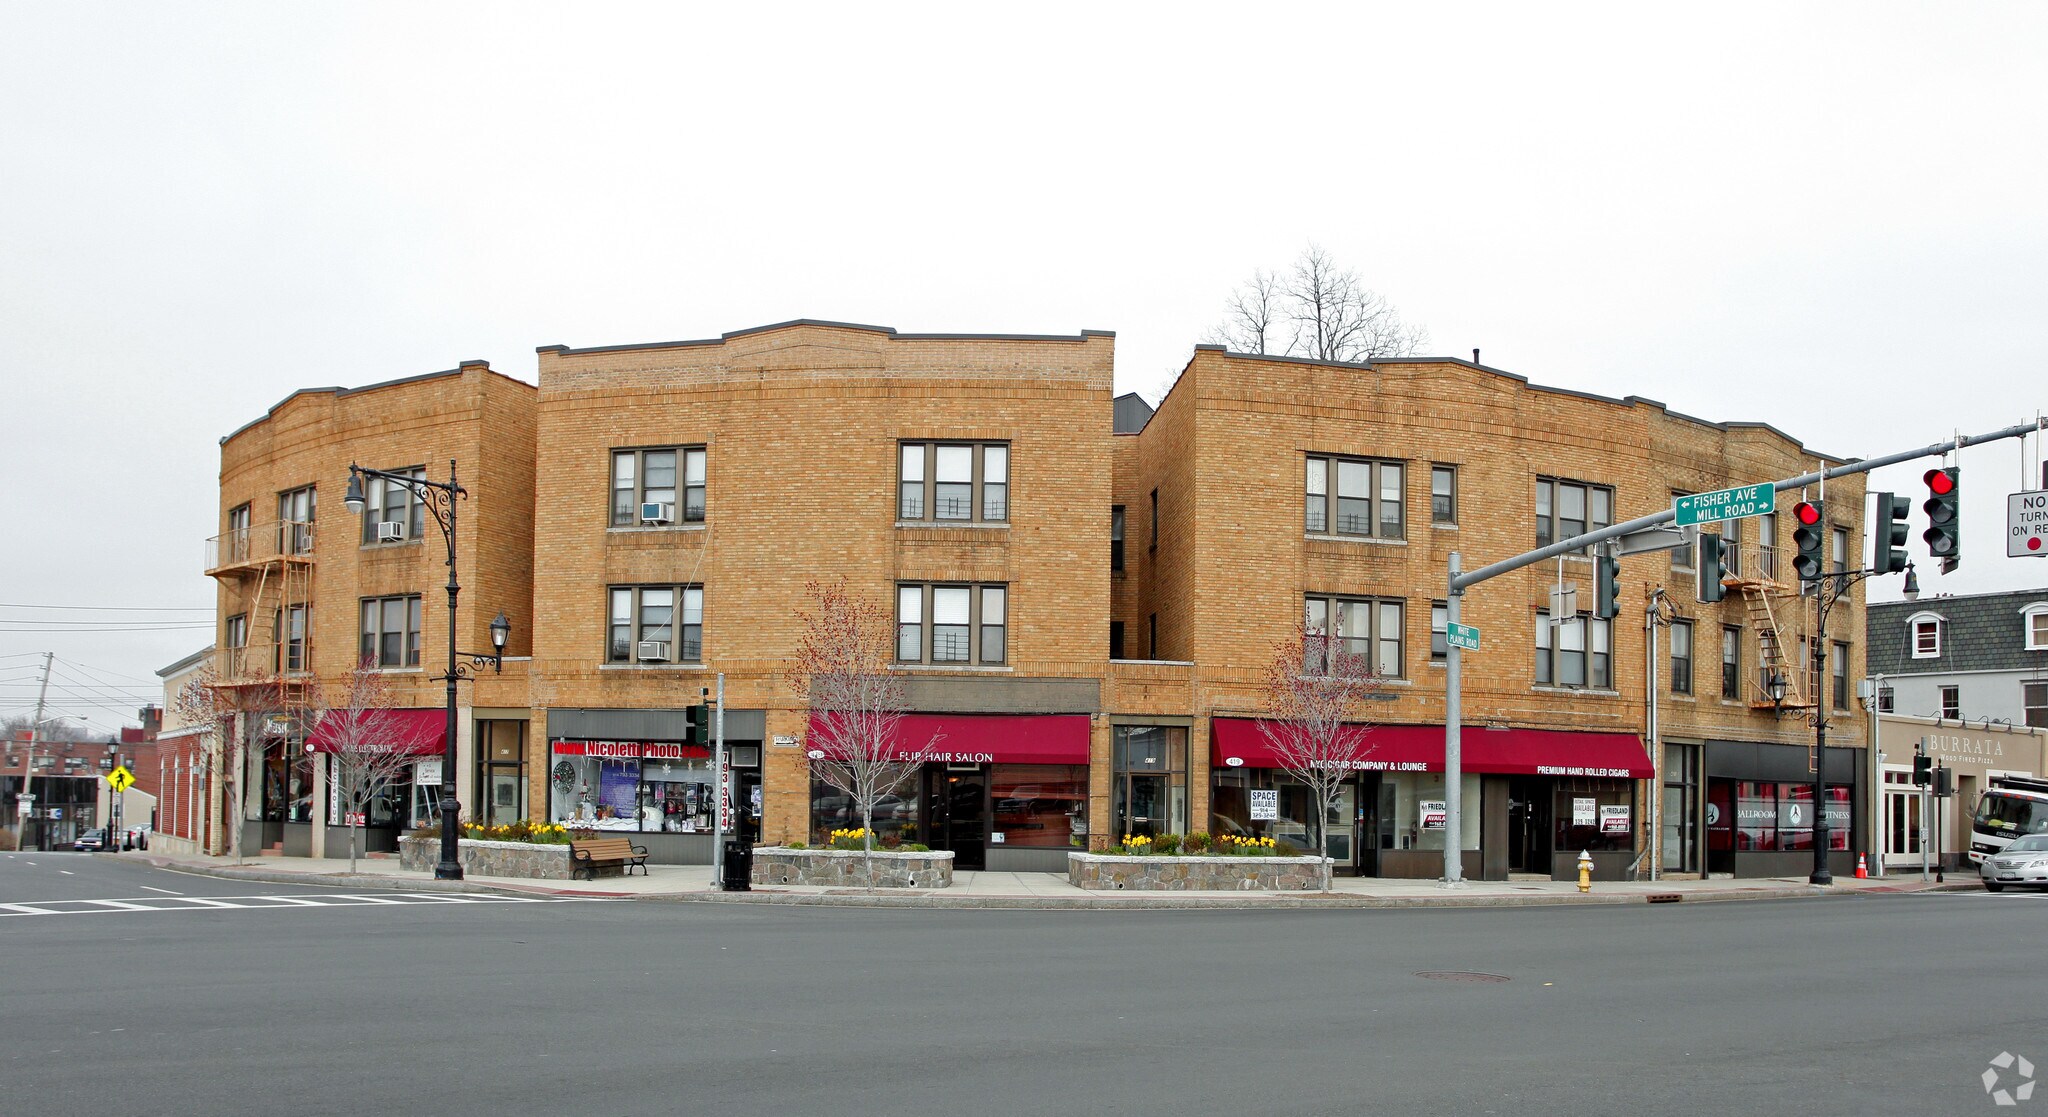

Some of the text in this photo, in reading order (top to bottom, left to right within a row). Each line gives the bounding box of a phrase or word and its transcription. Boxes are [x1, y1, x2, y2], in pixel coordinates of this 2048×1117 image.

[1693, 487, 1757, 509] FISHER AVE
[2023, 496, 2046, 510] NO
[1696, 501, 1754, 522] MILL ROAD
[2020, 511, 2048, 523] TURN
[2012, 523, 2048, 536] ON RE
[1450, 634, 1465, 646] PLAINS
[1930, 734, 2003, 756] BURRATA
[899, 751, 993, 763] FLIP HAIR SALON
[1352, 761, 1388, 770] COMPANY
[1389, 762, 1396, 770] &
[1397, 762, 1427, 771] LOUNGE
[1537, 765, 1630, 778] PREMIUM HAND ROLLED CIGARS
[1252, 792, 1276, 800] SPACE
[1606, 807, 1628, 815] FRIEDLAND
[1738, 809, 1850, 819] BALLROOM ITNESS
[1996, 831, 2020, 839] ISUZU
